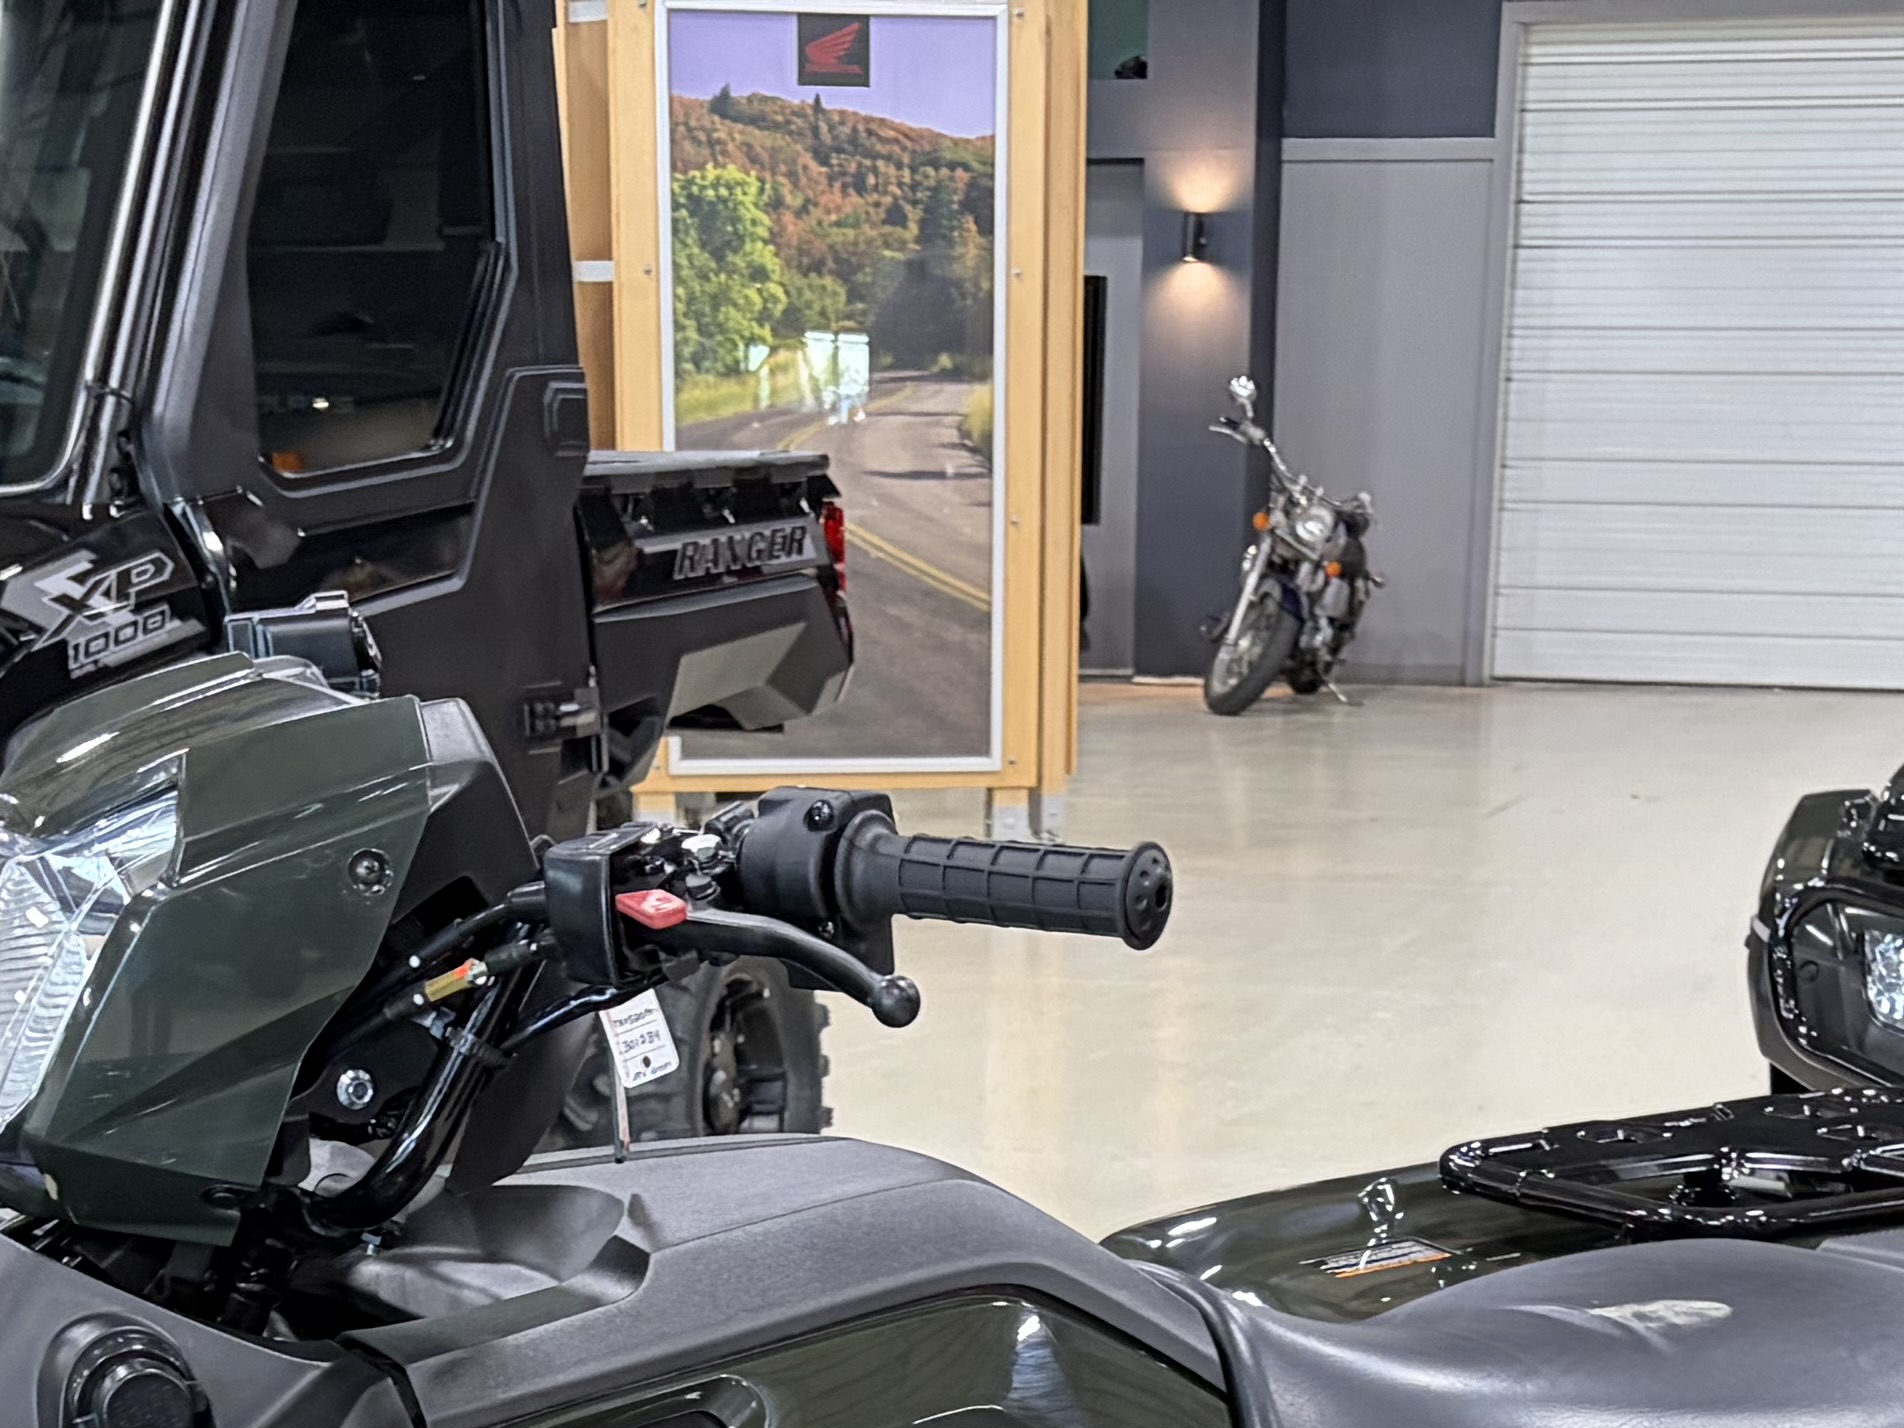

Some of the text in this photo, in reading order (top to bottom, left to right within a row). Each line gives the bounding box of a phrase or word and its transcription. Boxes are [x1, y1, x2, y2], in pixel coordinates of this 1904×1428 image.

[673, 525, 807, 580] RANGER
[32, 552, 175, 652] XP
[69, 603, 170, 672] 1000
